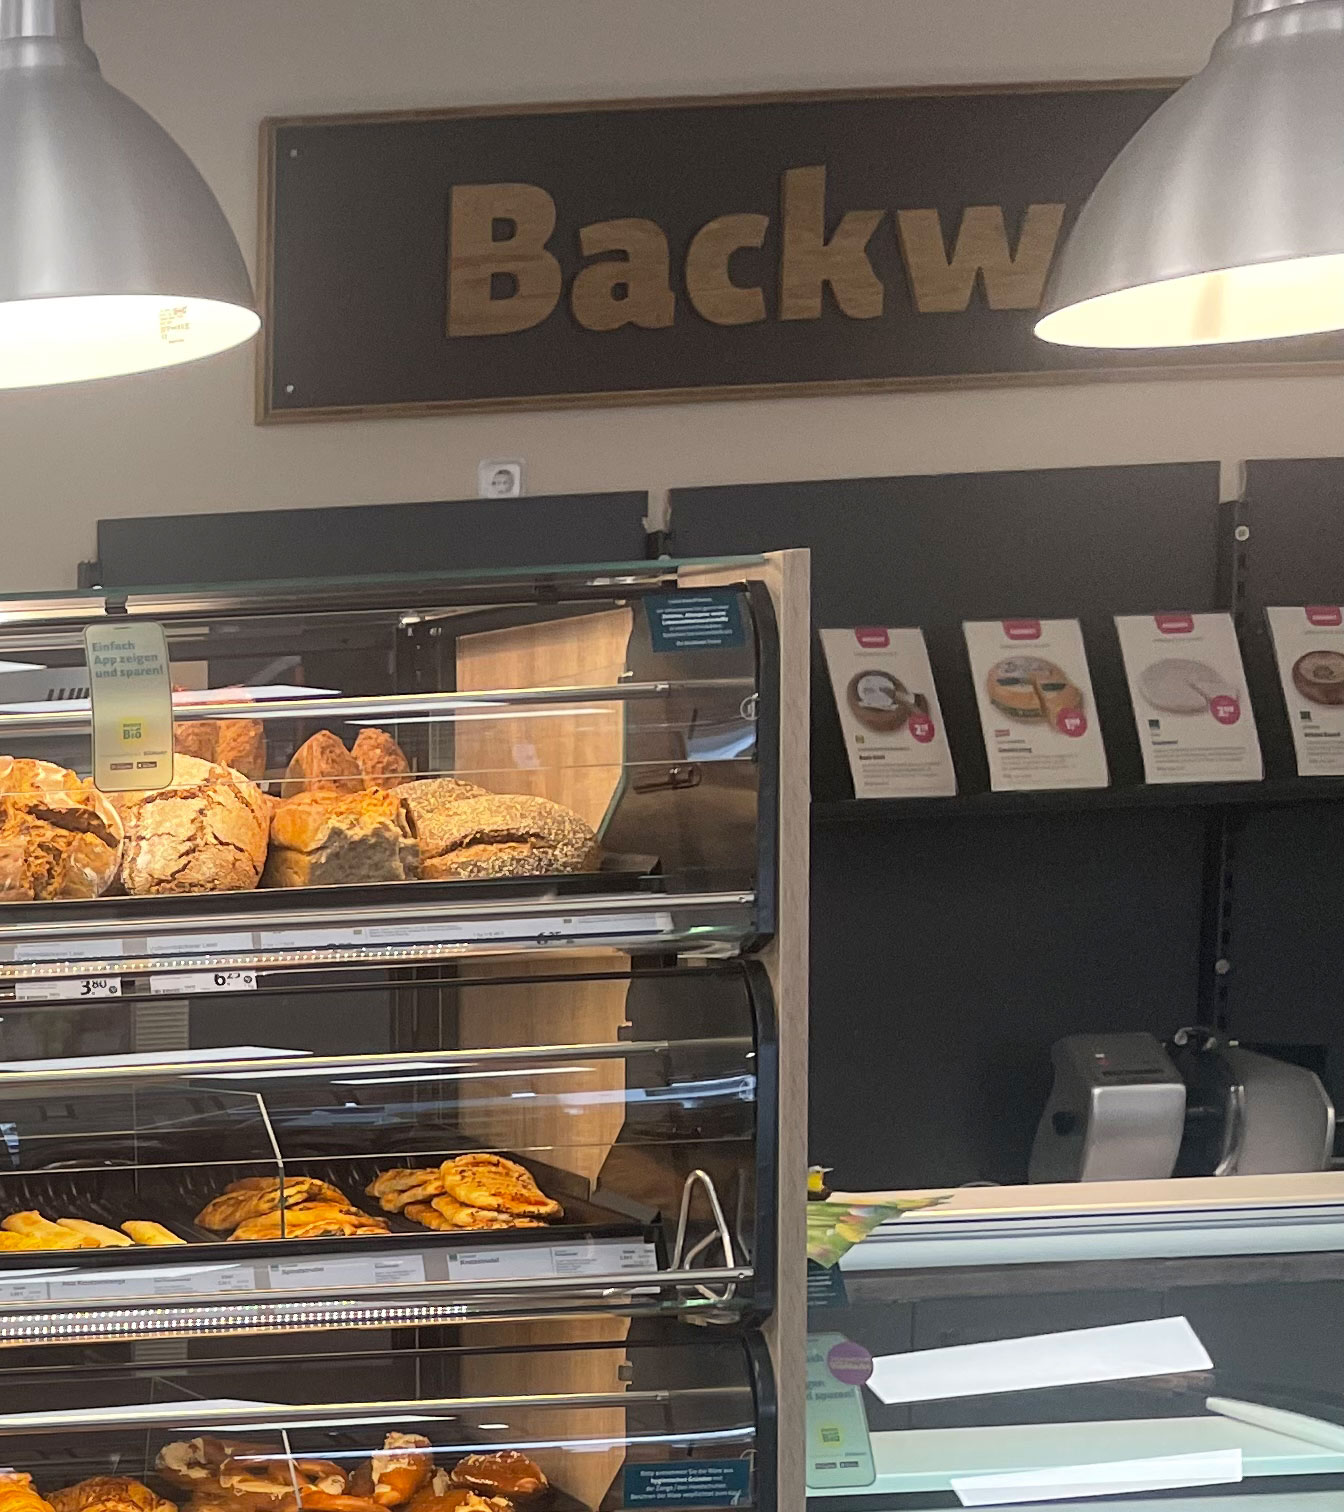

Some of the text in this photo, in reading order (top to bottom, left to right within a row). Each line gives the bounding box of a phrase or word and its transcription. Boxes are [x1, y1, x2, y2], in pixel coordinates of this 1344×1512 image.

[92, 642, 135, 652] Einfach
[94, 653, 158, 666] App zeigen
[95, 668, 117, 678] und
